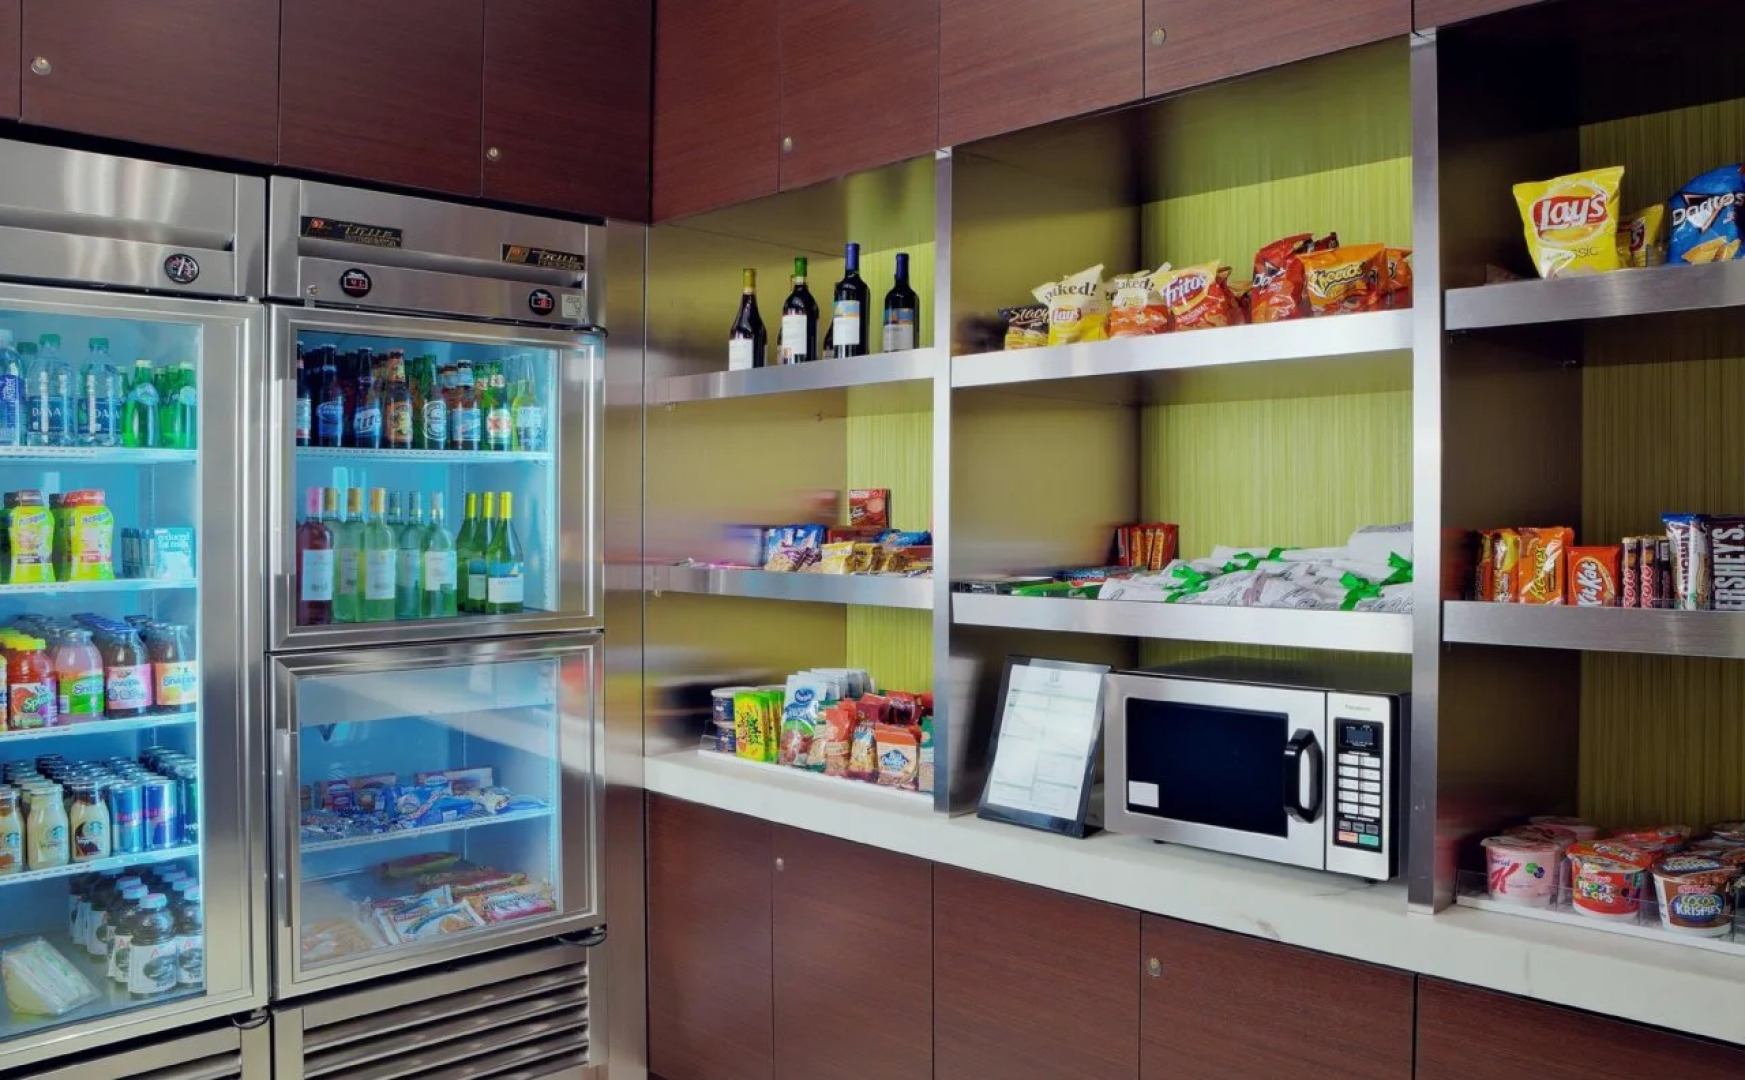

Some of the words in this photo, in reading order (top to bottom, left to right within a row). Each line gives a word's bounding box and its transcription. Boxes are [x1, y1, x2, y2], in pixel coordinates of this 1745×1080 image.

[1540, 189, 1608, 231] Lay's
[1163, 272, 1208, 306] Fritos
[1675, 901, 1722, 917] KRISPIES
